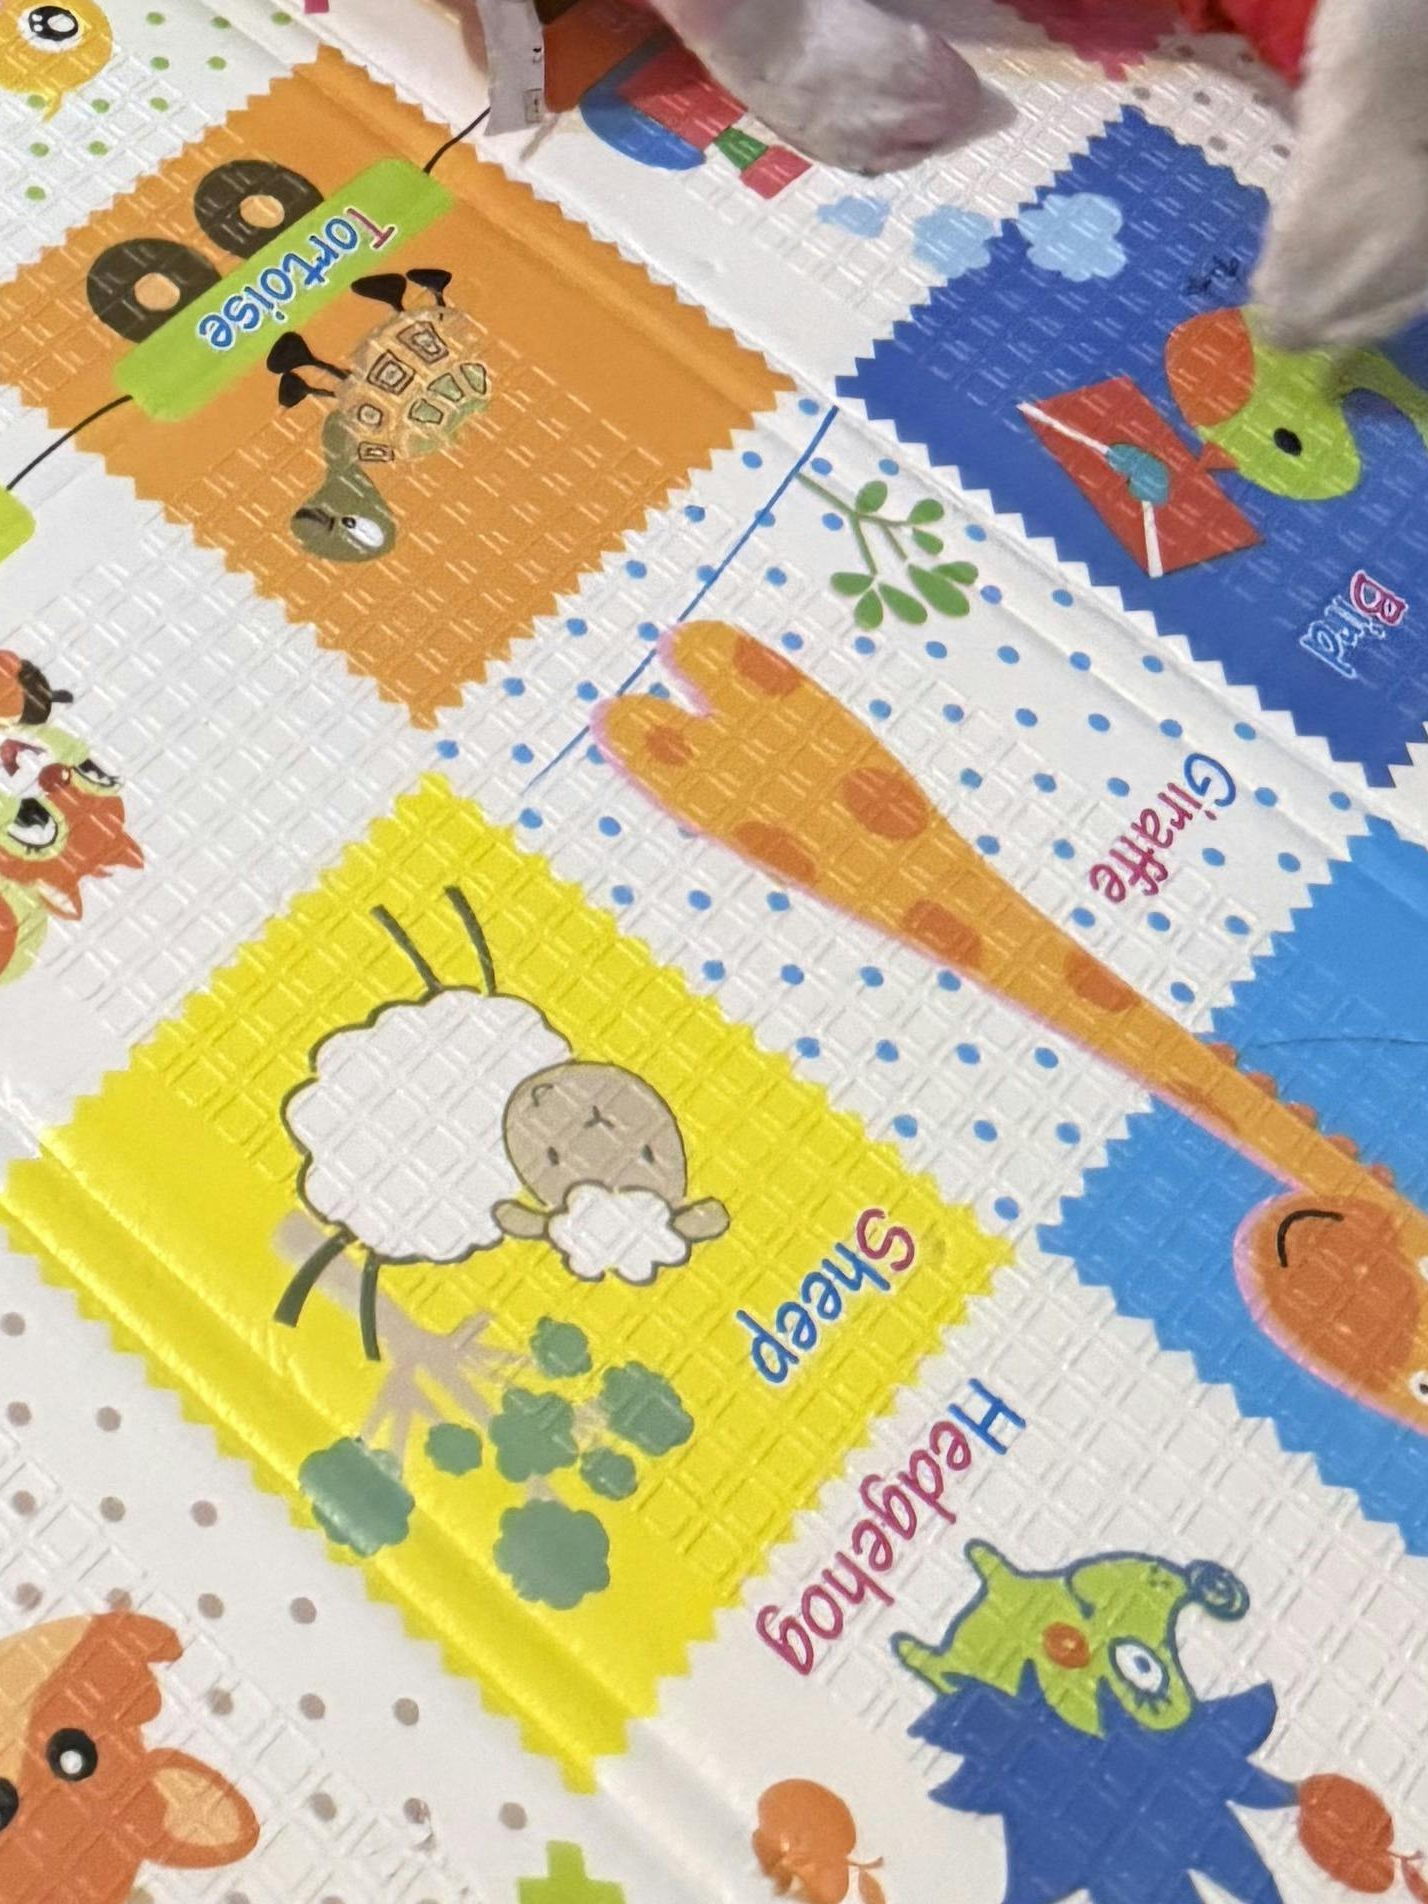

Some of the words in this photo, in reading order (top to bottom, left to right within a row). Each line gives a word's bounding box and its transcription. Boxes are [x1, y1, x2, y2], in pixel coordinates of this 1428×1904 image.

[198, 201, 397, 353] Tortoise
[1298, 570, 1408, 677] Bird
[1089, 752, 1236, 912] Giraffe
[736, 1206, 918, 1387] Sheep
[756, 1377, 1026, 1675] Hedgehog
